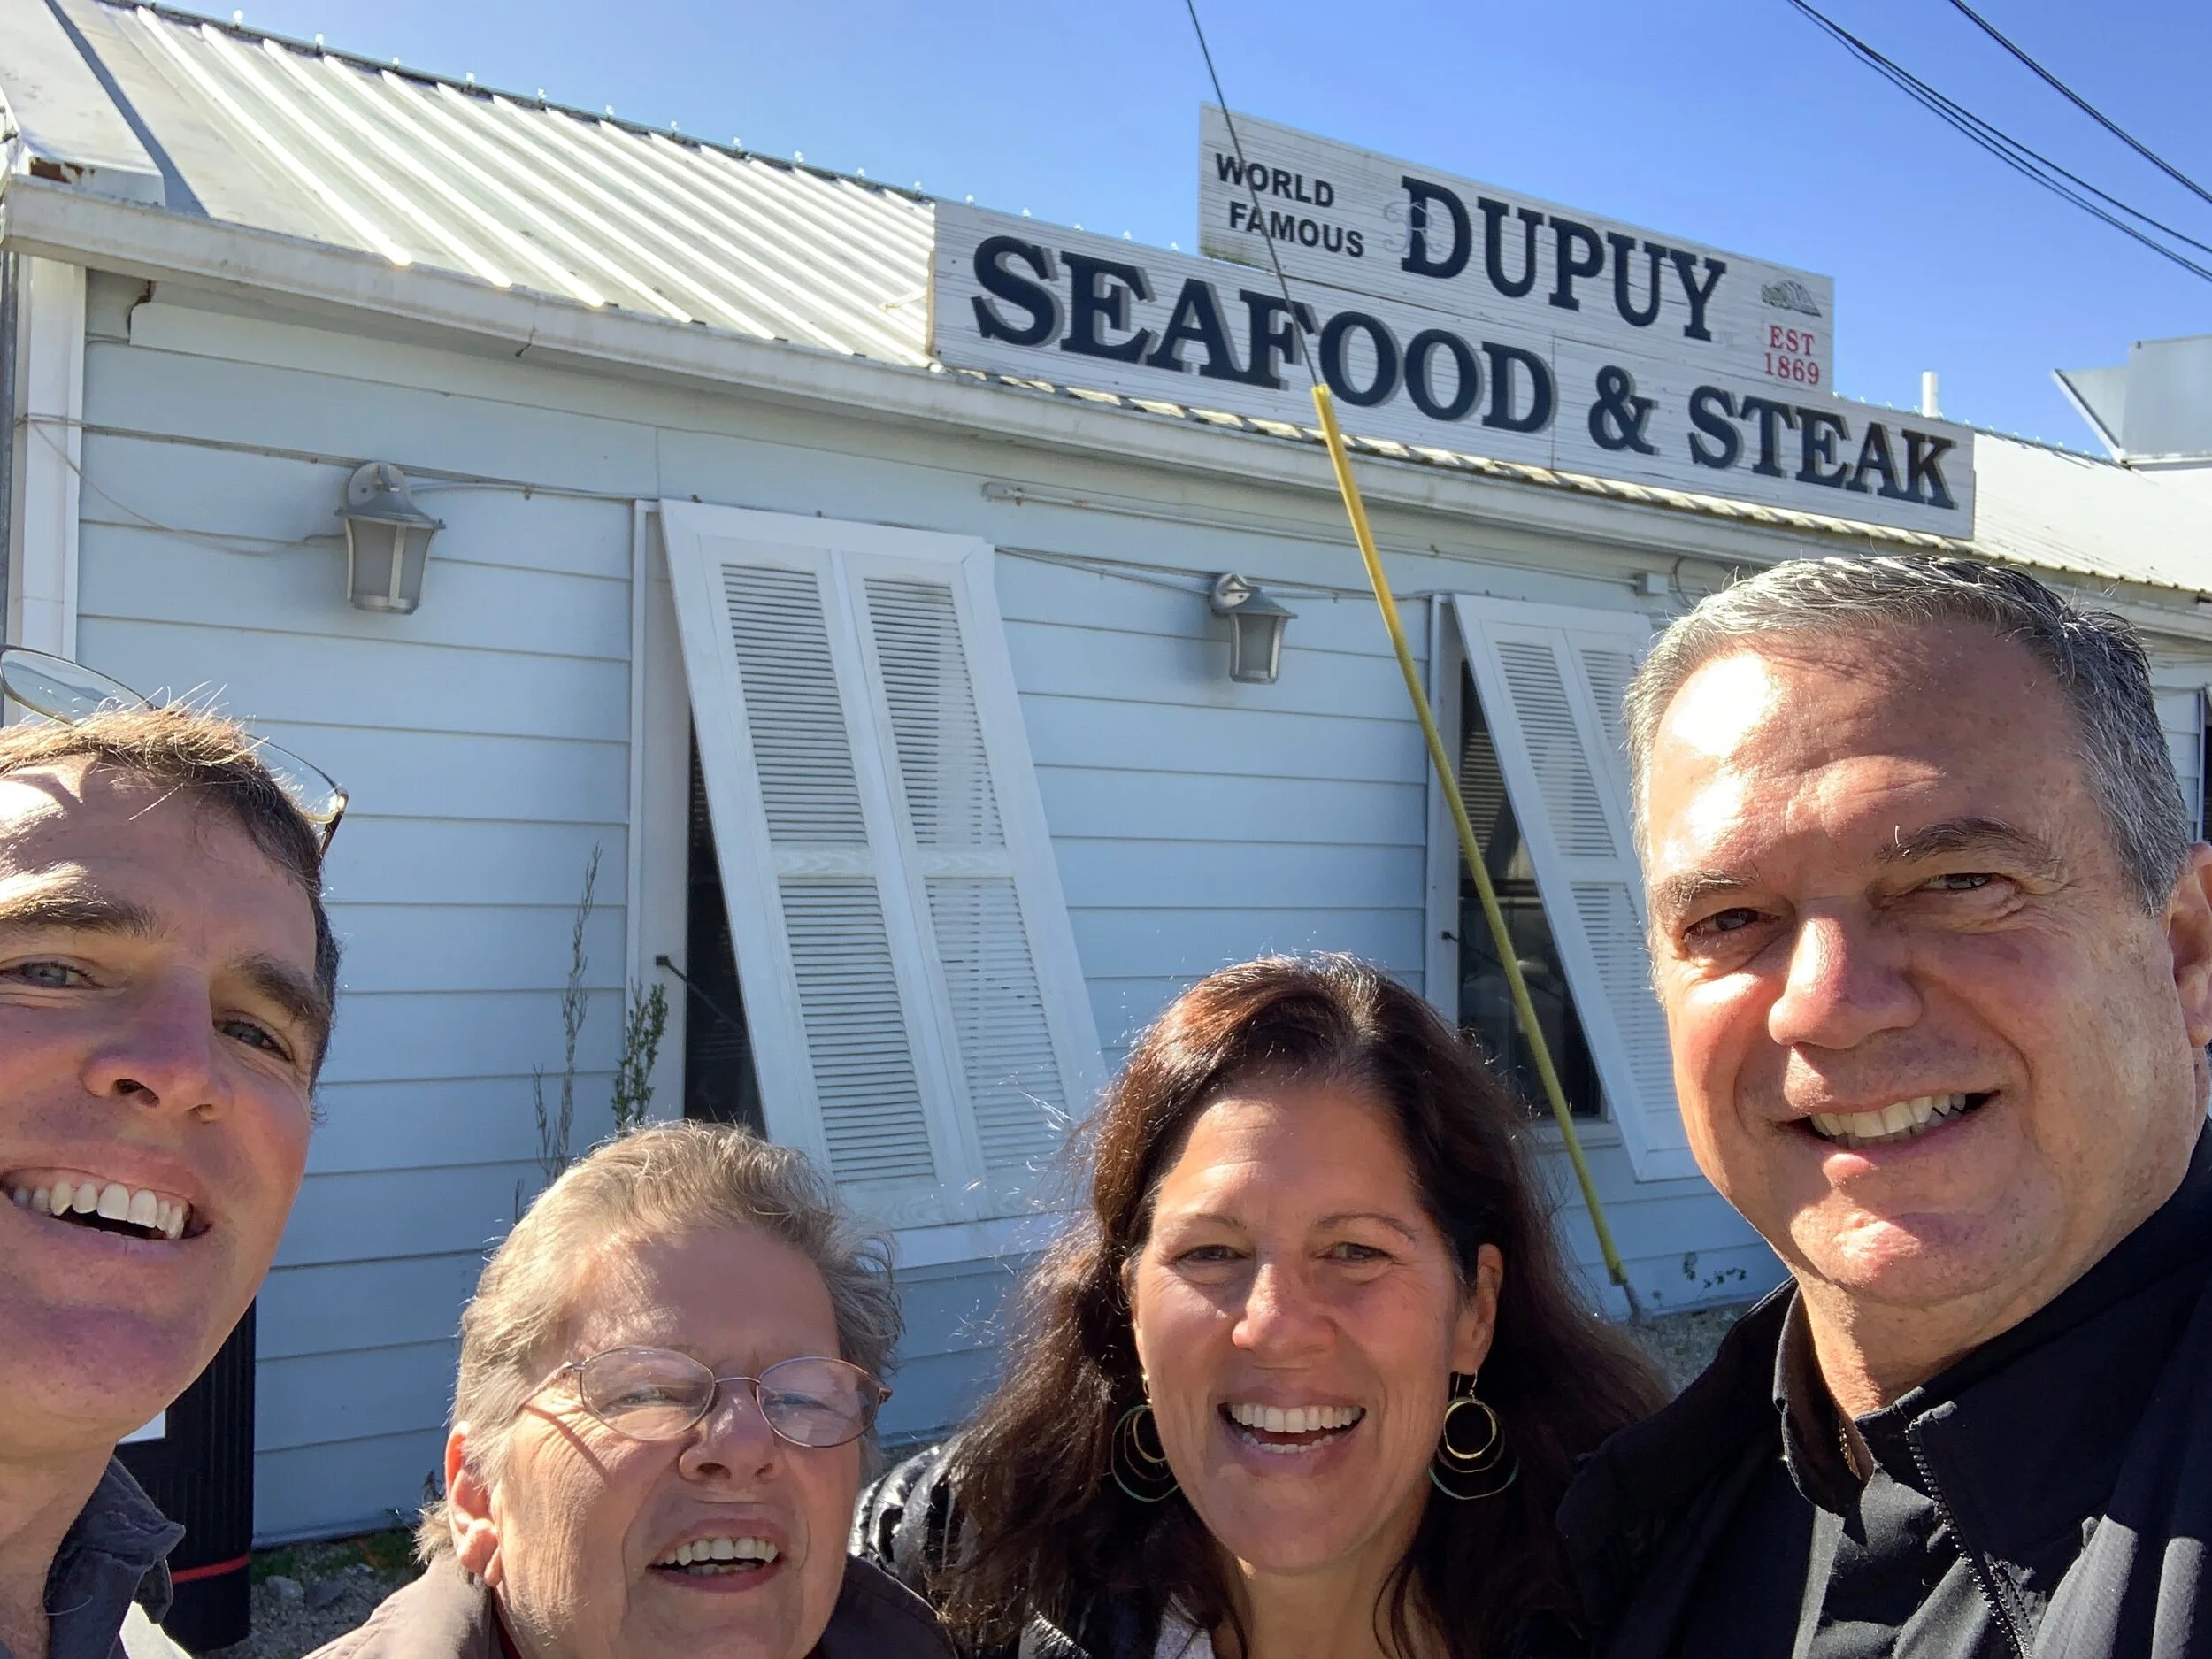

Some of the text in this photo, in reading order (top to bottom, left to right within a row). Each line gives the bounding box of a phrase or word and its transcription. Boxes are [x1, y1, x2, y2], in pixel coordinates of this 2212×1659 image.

[1215, 152, 1335, 208] WORLD
[1229, 201, 1365, 258] FAMOUS
[1400, 174, 1727, 342] DUPUY
[1769, 324, 1816, 357] EST
[970, 234, 1959, 510] SEAFOOD & STEAK
[1763, 352, 1821, 386] 1869
